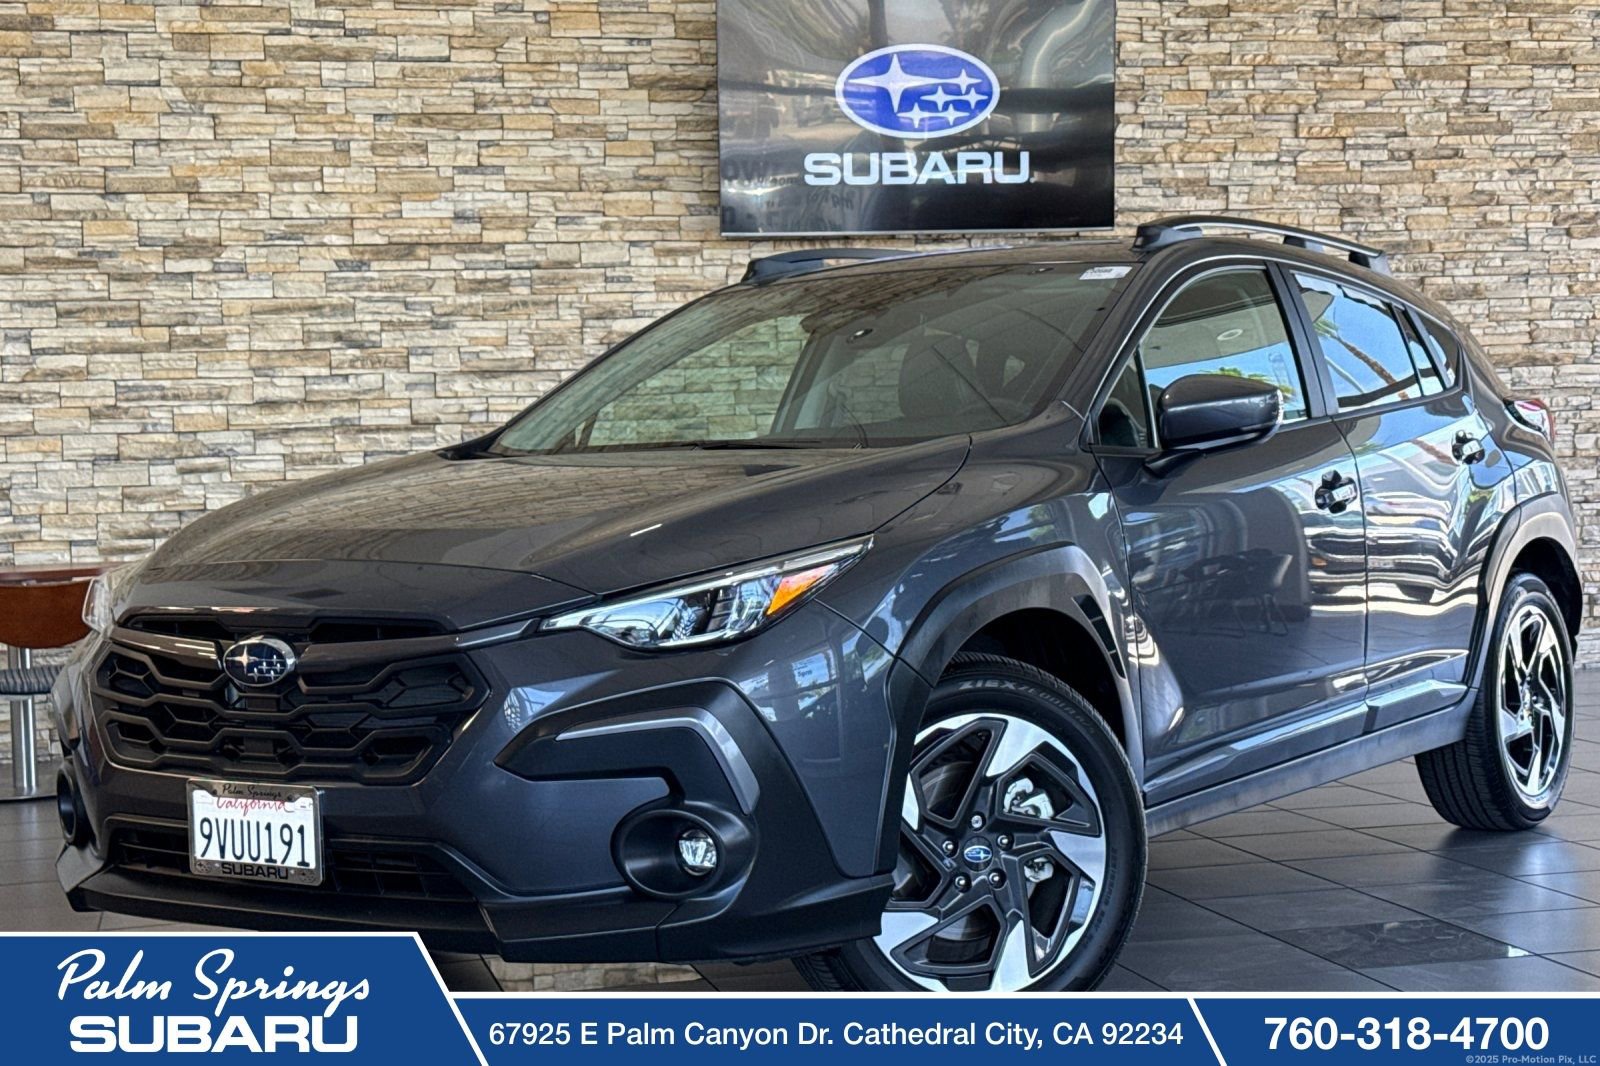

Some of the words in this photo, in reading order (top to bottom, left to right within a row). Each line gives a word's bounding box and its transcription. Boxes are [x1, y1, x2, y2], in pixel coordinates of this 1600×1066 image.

[804, 152, 1030, 186] SUBARU
[959, 679, 1017, 690] ZIEX
[222, 783, 244, 794] Palm
[247, 784, 283, 801] Springs
[200, 817, 310, 867] 9VUU191
[221, 862, 289, 879] SUBARU
